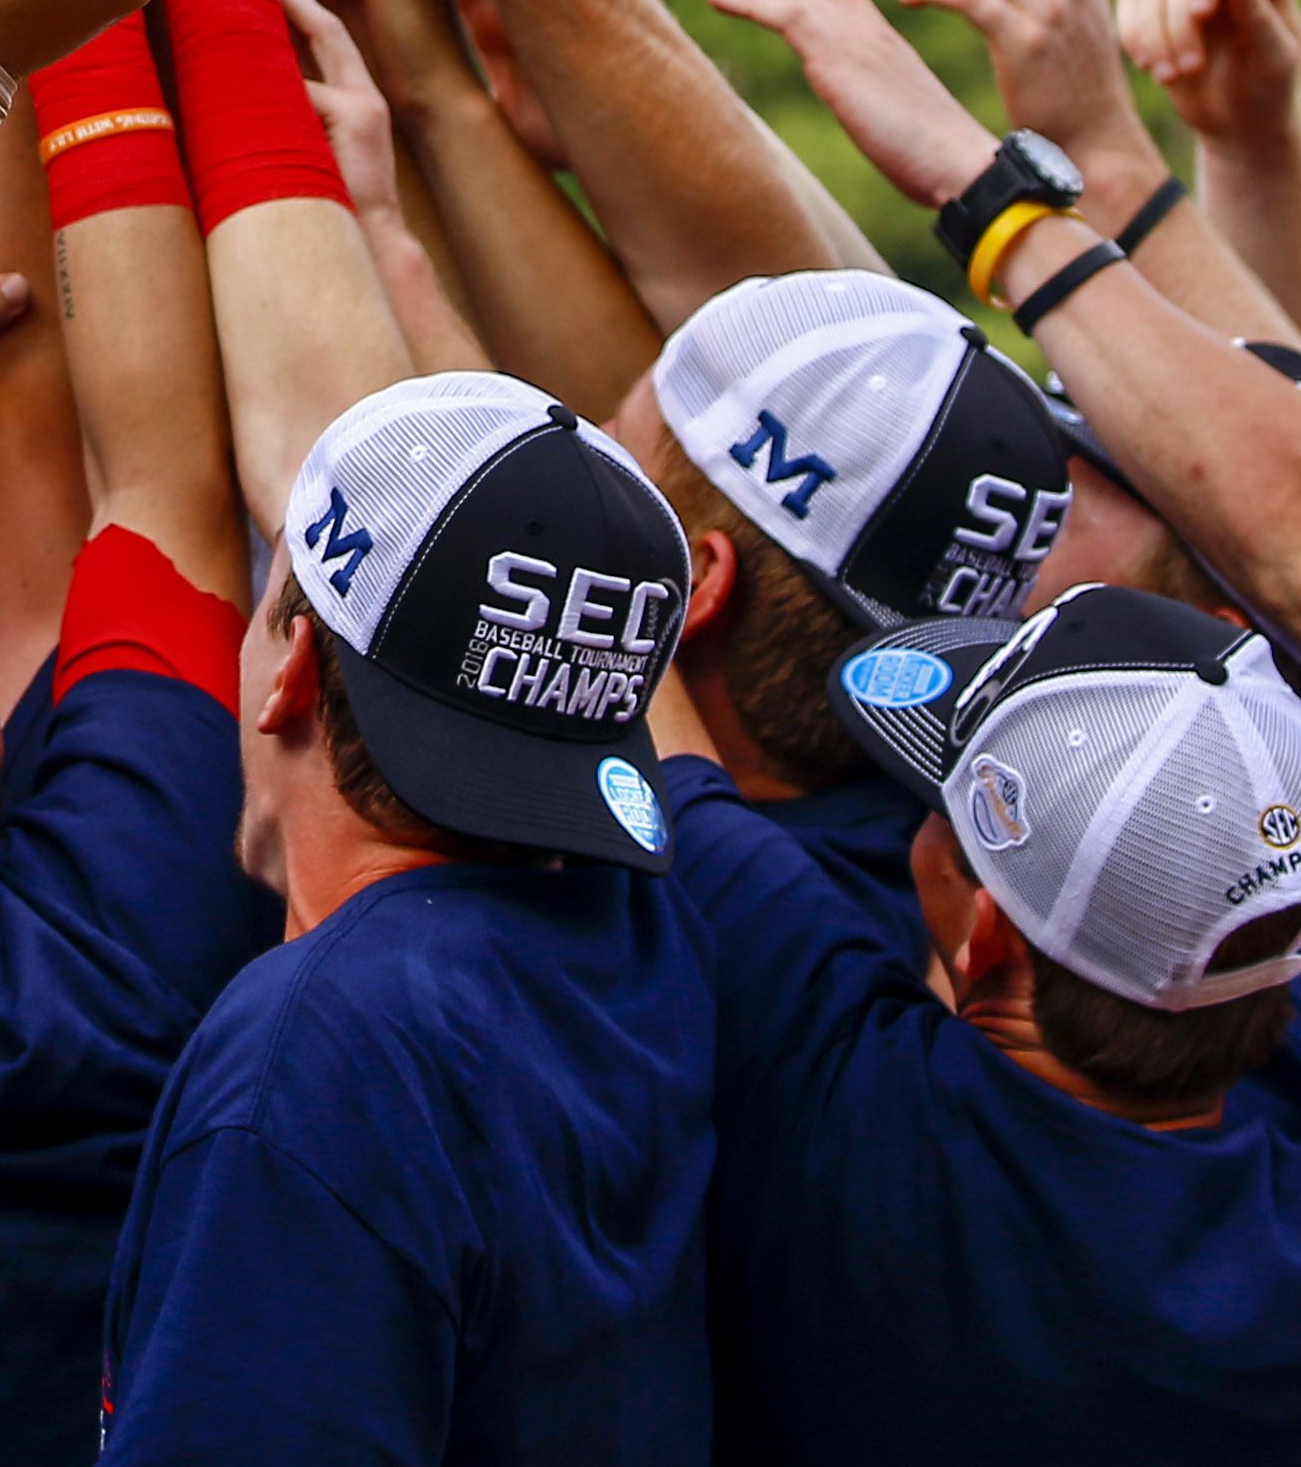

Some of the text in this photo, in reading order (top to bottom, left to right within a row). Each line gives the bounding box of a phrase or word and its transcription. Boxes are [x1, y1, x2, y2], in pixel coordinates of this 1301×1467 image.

[728, 409, 838, 520] M
[305, 487, 373, 598] M
[954, 473, 1073, 560] SE
[479, 551, 668, 653] SEC
[474, 620, 649, 674] BASEBALL TOURNAMENT
[478, 646, 644, 721] CHAMPS
[1263, 808, 1298, 844] SEC
[1226, 852, 1301, 905] CHAMP
